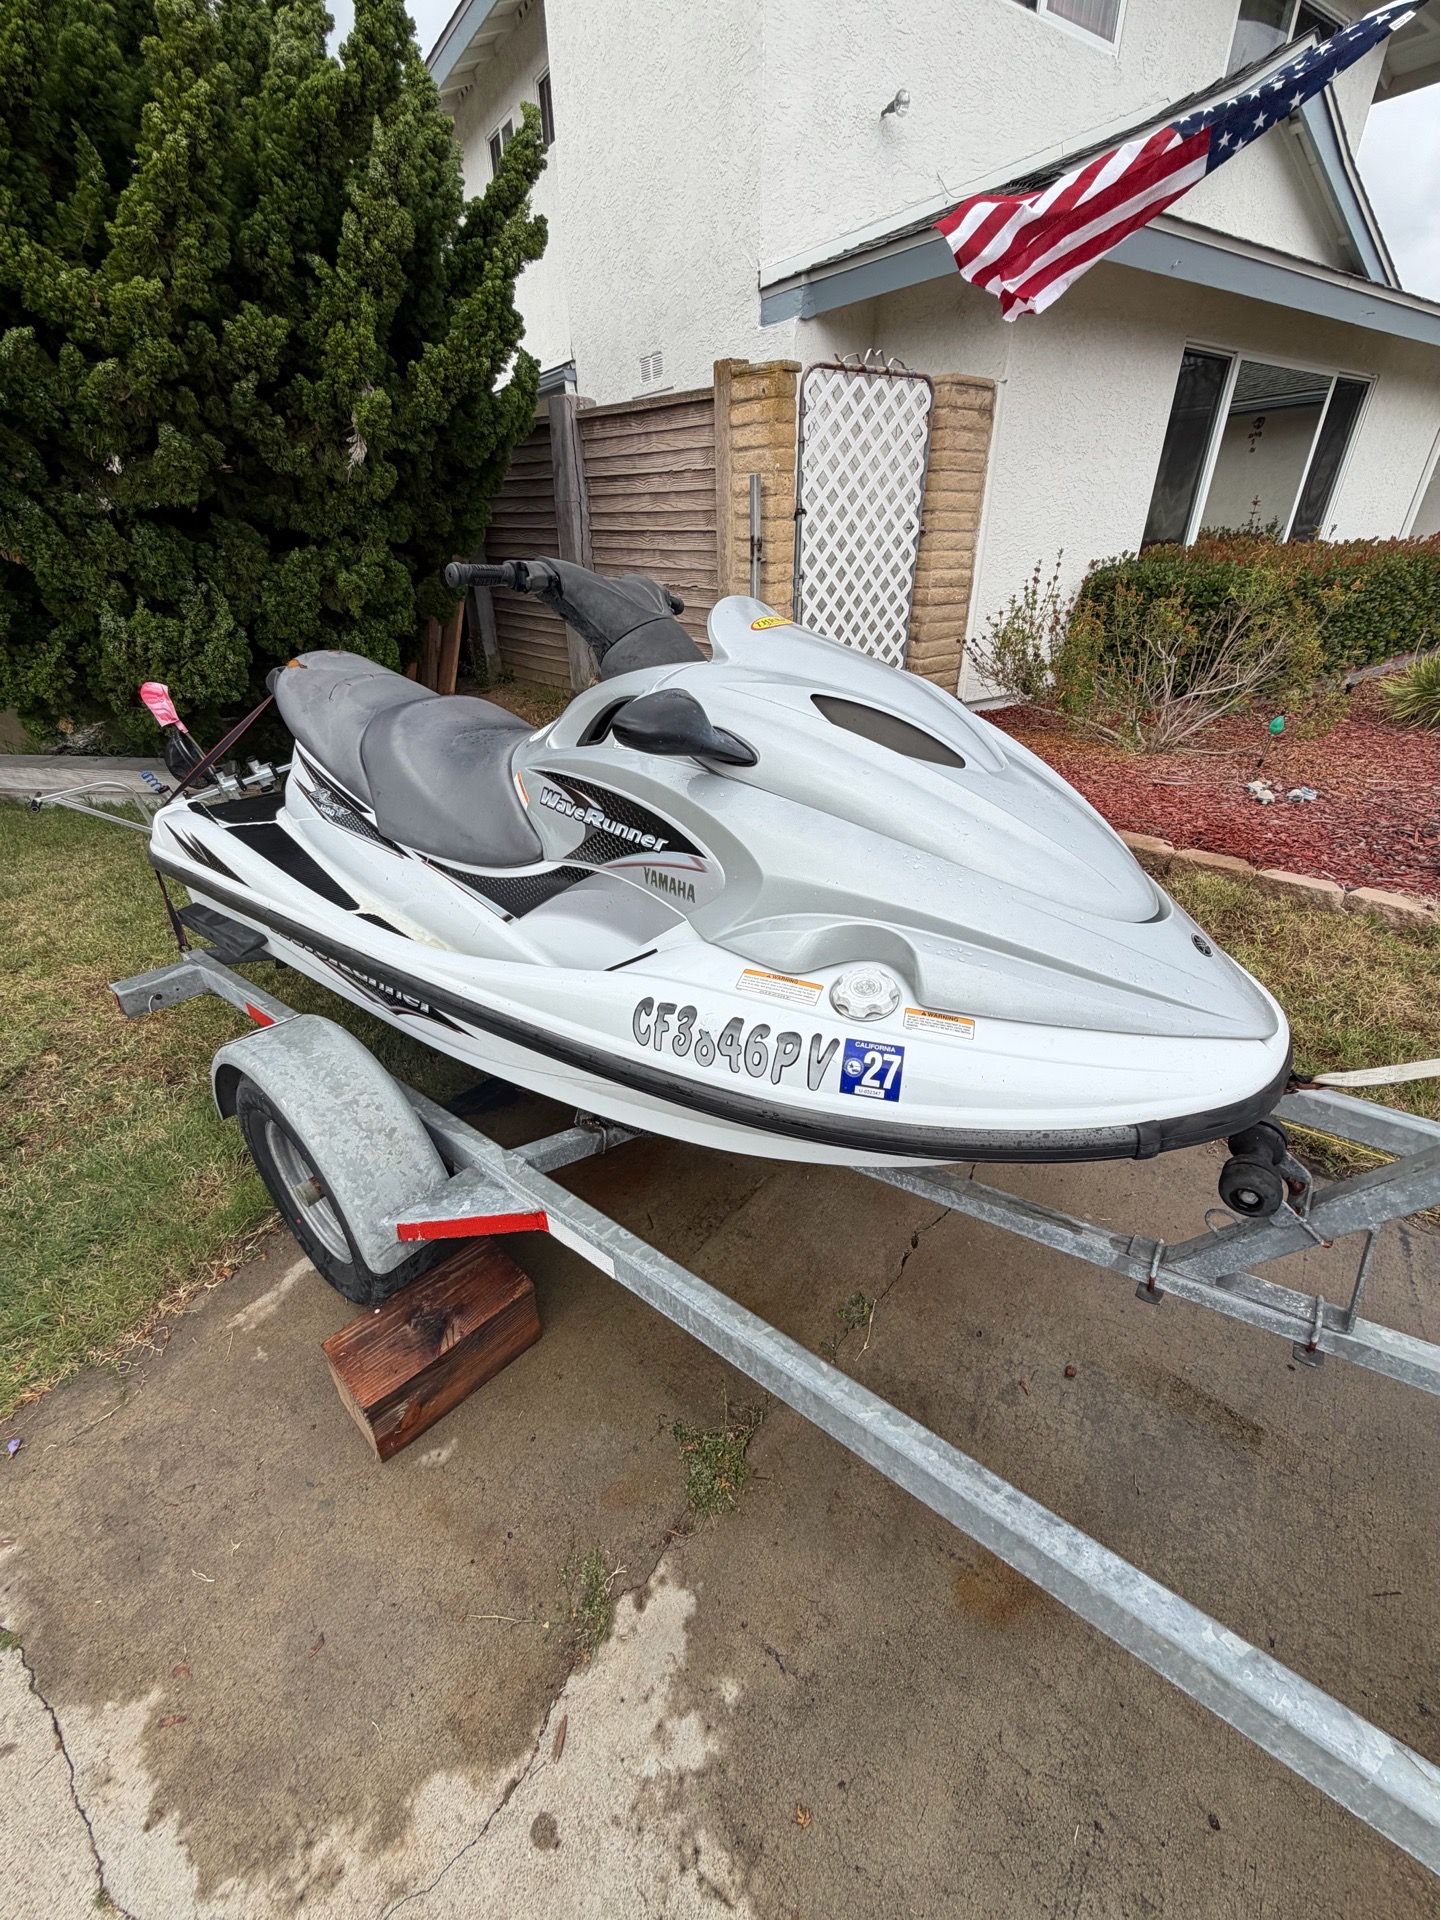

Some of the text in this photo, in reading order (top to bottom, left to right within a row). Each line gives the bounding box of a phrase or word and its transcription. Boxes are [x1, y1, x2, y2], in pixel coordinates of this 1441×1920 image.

[539, 785, 670, 854] WaveRunner
[643, 866, 697, 904] YAMAHA
[772, 974, 799, 985] WARNING
[927, 1011, 960, 1023] WARNING
[854, 1041, 897, 1053] CALIFORNIA
[861, 1050, 903, 1090] 27
